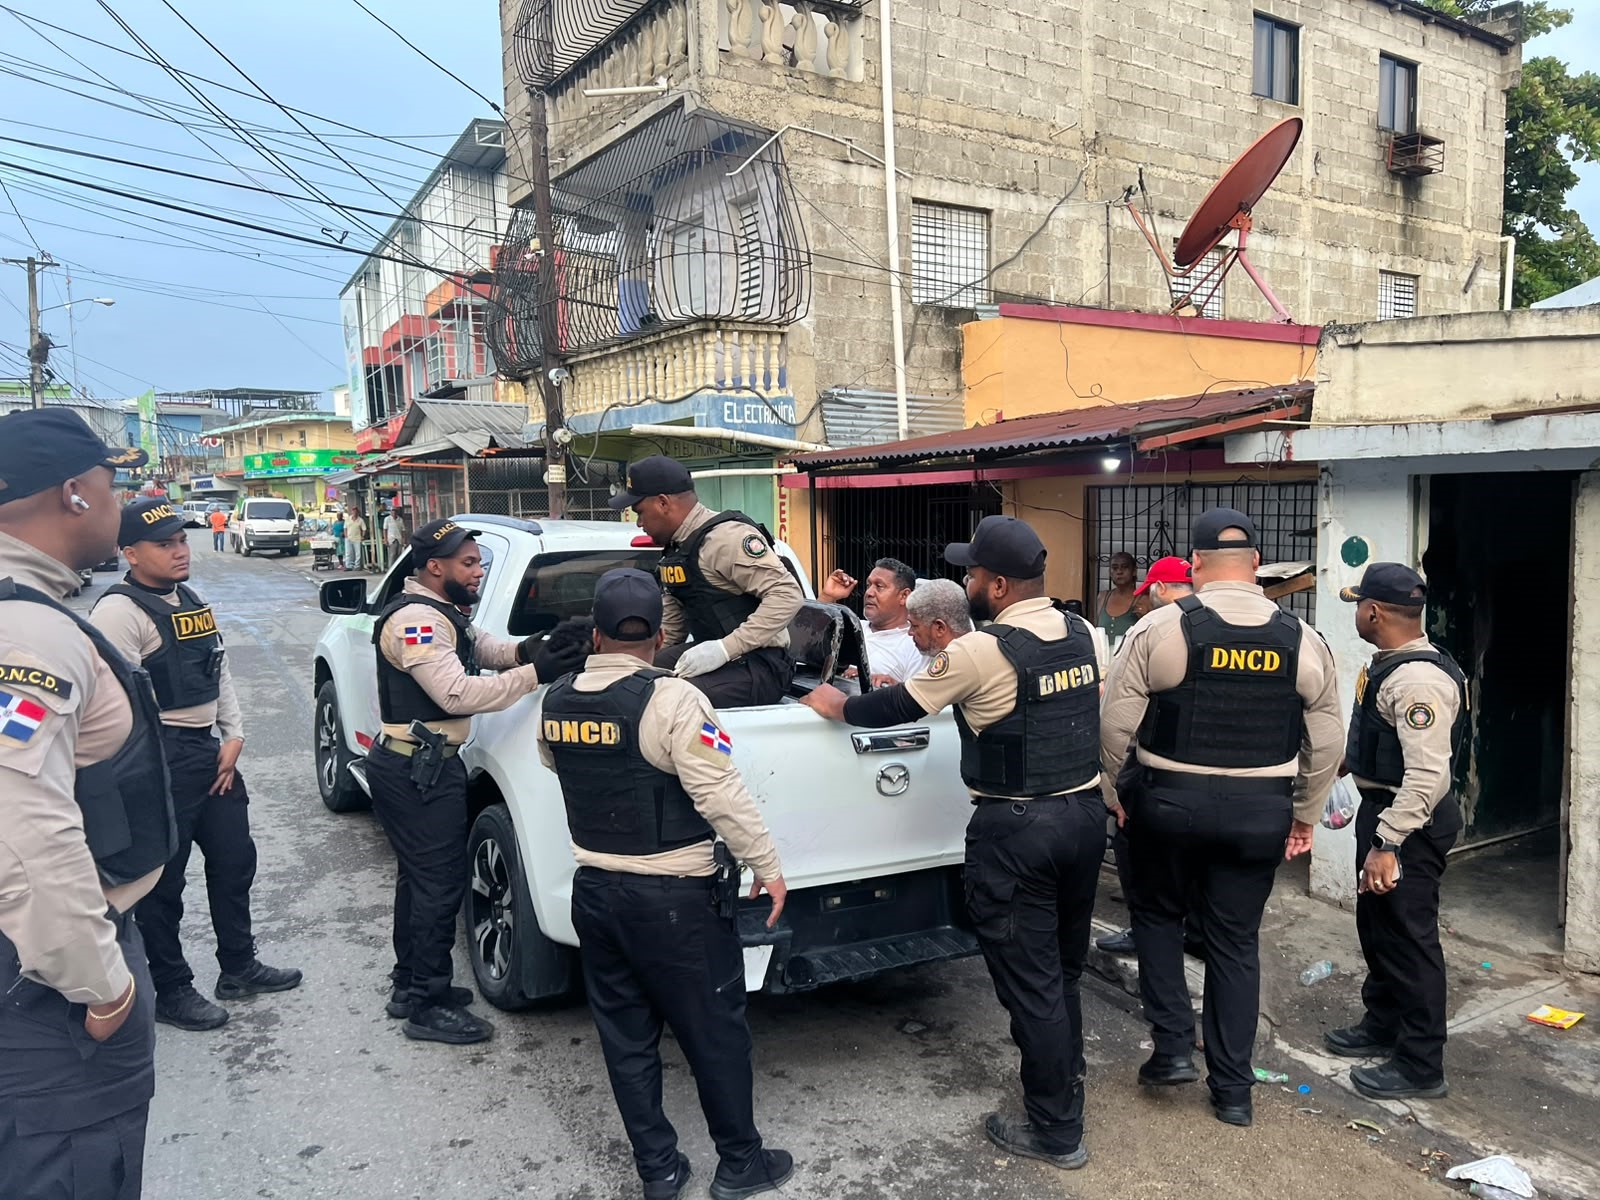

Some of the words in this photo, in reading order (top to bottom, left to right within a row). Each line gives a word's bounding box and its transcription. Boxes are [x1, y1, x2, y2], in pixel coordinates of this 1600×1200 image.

[1210, 647, 1281, 672] DNCD
[1038, 663, 1095, 697] DNCD
[543, 719, 621, 745] DNCD
